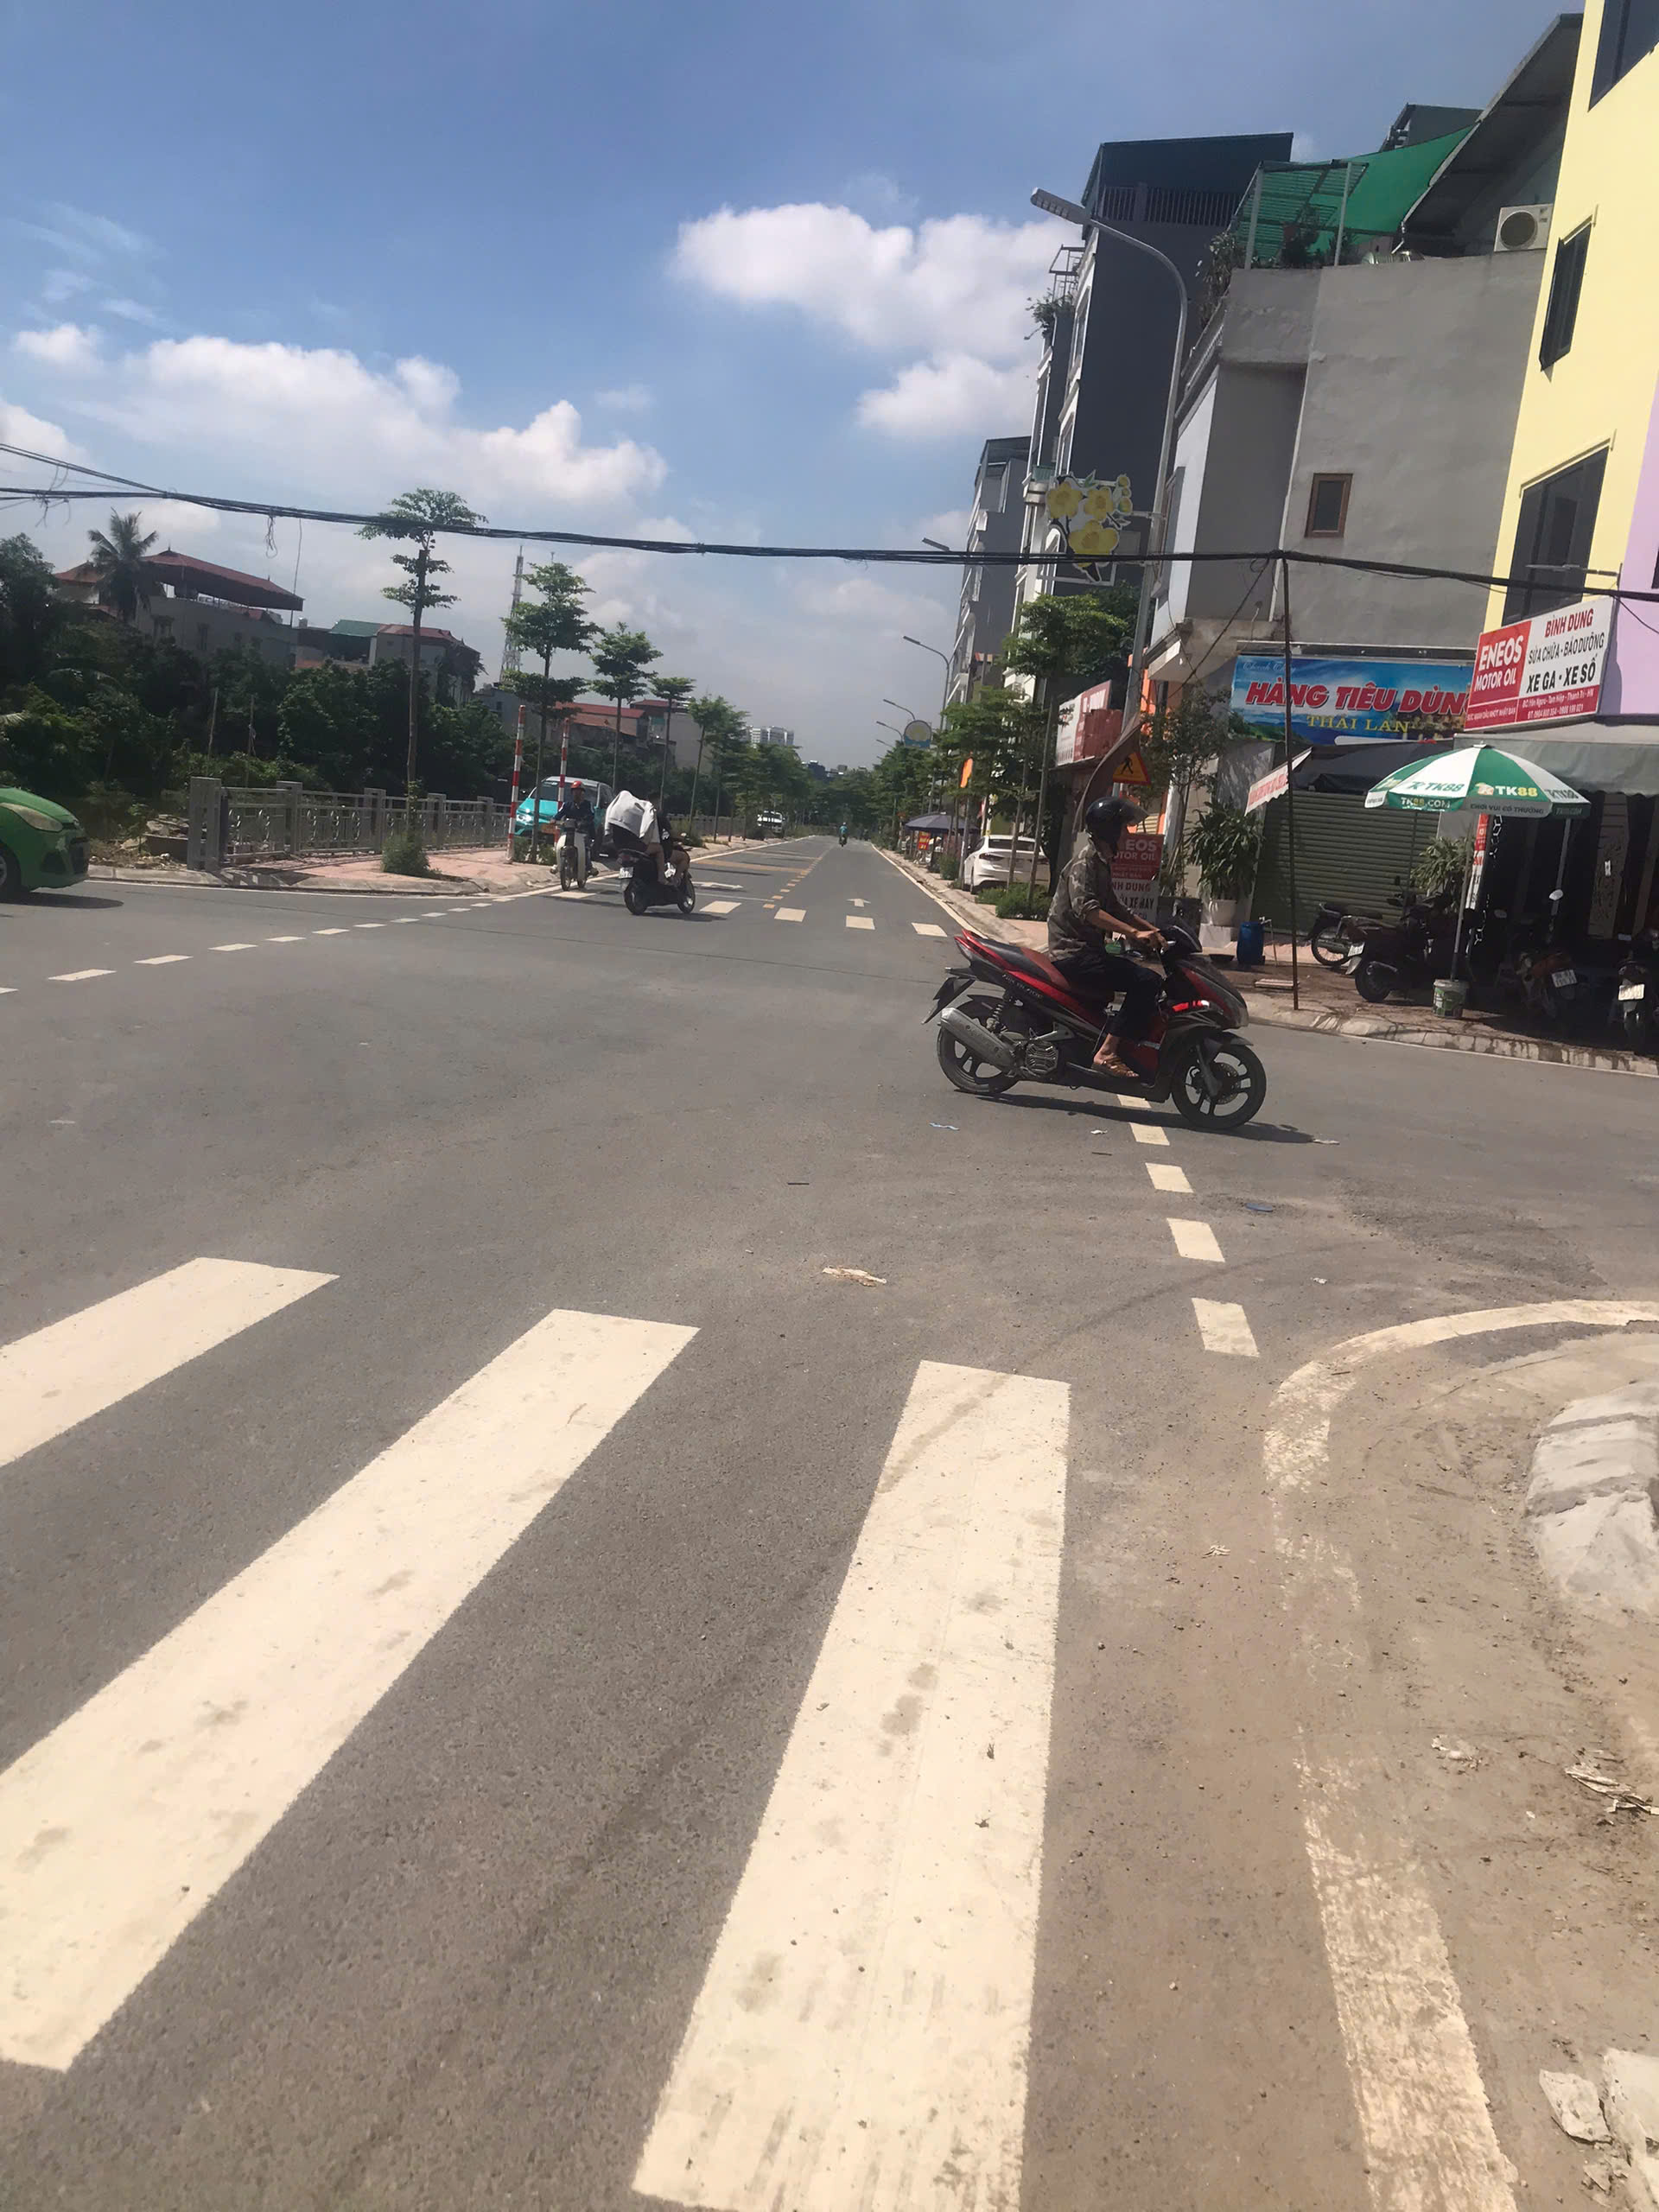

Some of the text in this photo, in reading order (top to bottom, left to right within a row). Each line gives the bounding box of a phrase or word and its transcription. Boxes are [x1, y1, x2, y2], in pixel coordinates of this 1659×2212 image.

[1545, 607, 1594, 638] BÌNH DUNG
[1478, 635, 1523, 671] ENEOS
[1474, 668, 1517, 691] MOTOR OIL
[1526, 653, 1598, 693] XE GA XE SỐ
[1245, 677, 1472, 715] HÀNG TIÊU DÙN
[1366, 719, 1411, 733] LAN
[1425, 782, 1465, 792] TK88
[1495, 785, 1538, 798] TK88
[1401, 797, 1451, 809] TK88.COM
[1125, 839, 1158, 851] EOS
[1141, 852, 1155, 861] OIL
[1126, 882, 1152, 892] DUNG
